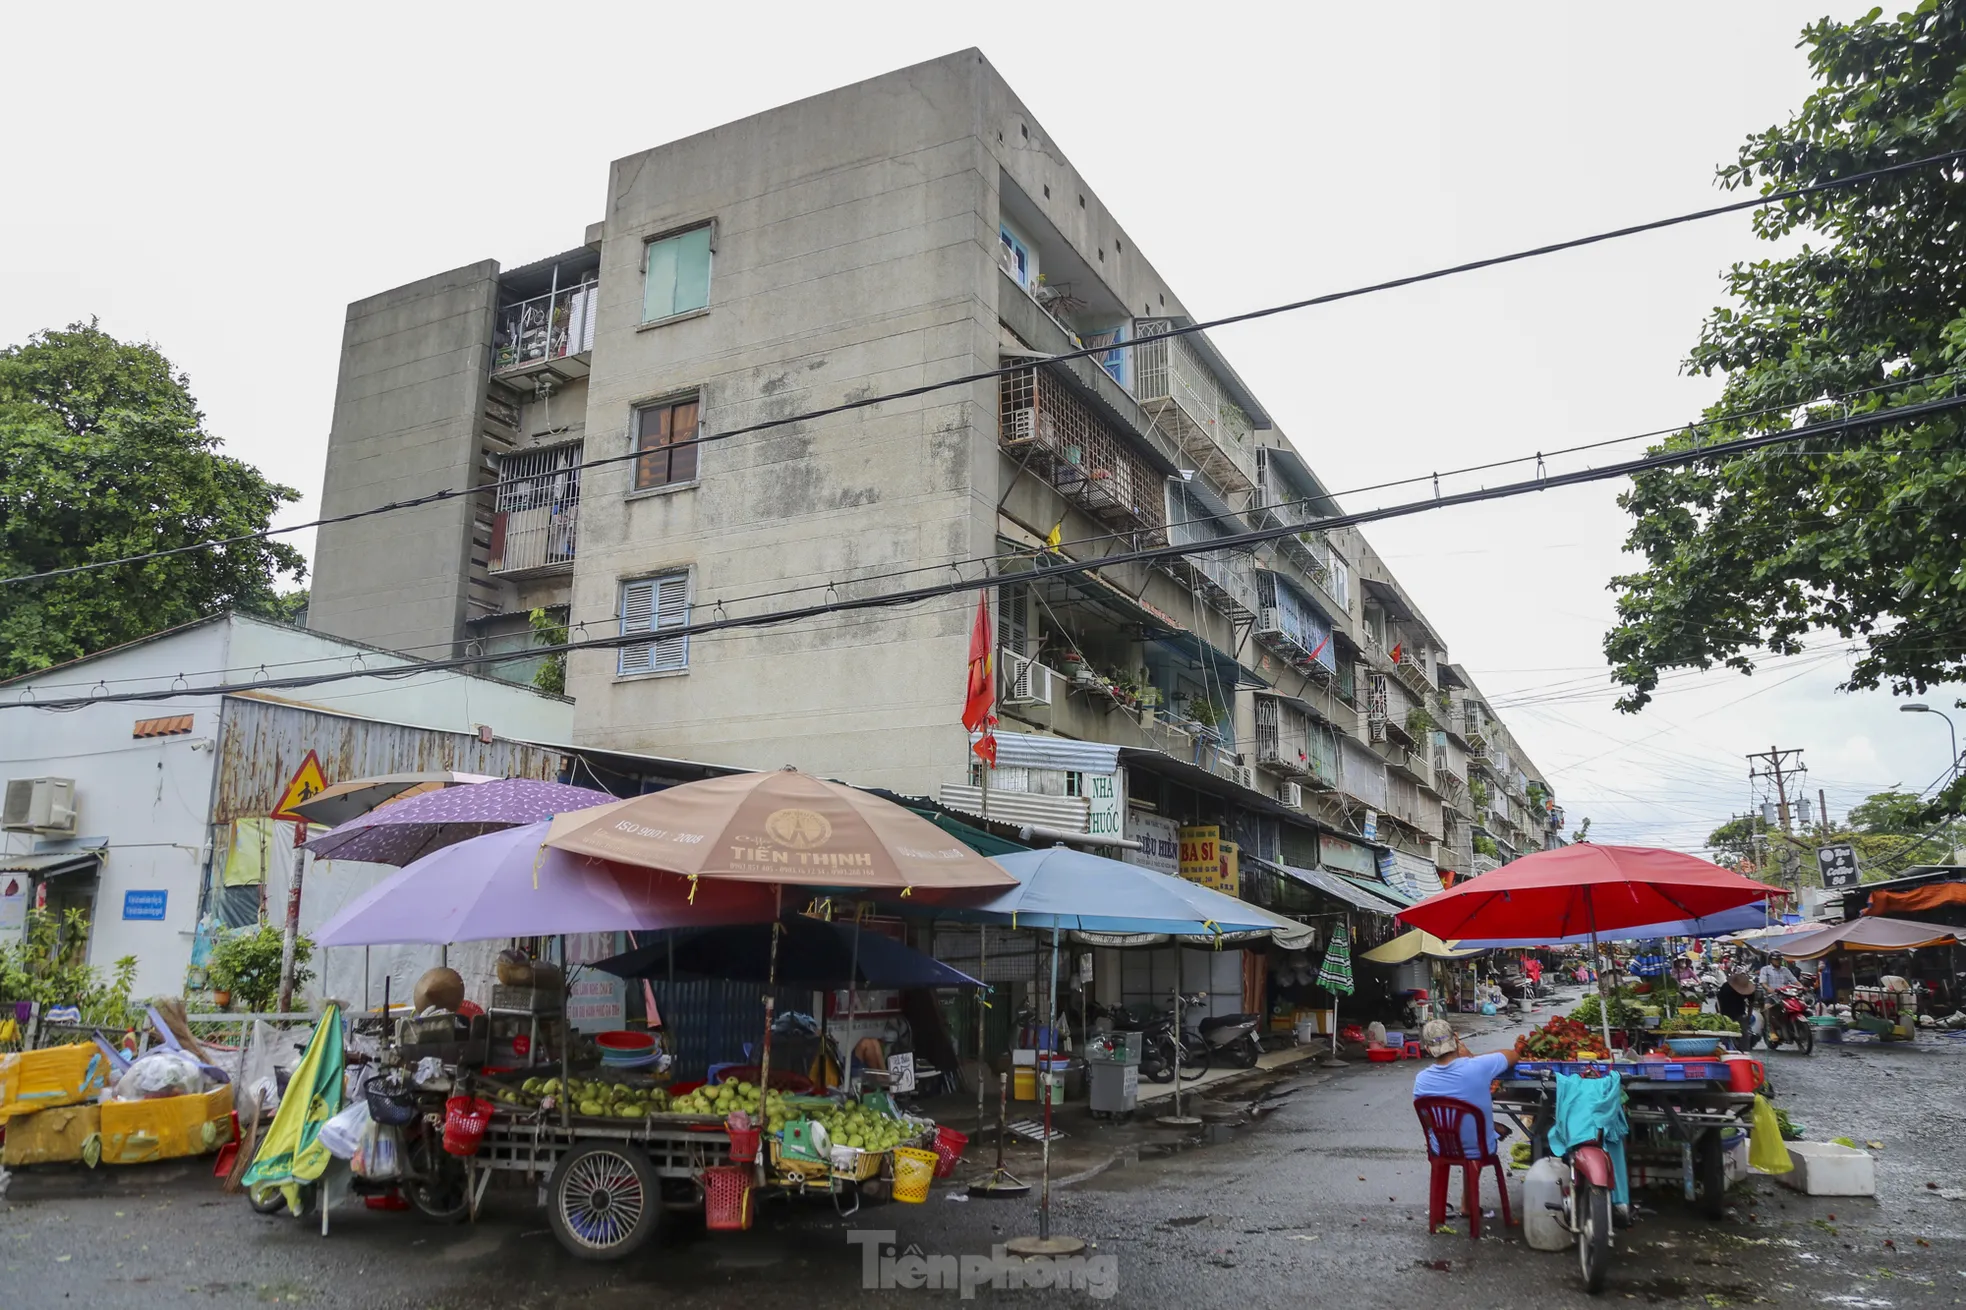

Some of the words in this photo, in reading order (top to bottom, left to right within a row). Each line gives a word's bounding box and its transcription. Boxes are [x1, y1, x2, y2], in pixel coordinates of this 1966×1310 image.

[615, 819, 640, 833] ISO
[637, 826, 668, 840] 9001
[673, 832, 705, 844] 2008
[730, 844, 788, 864] TIẾN
[796, 852, 872, 869] THỊNH
[1159, 832, 1178, 861] HIỀN
[1181, 842, 1198, 862] BA
[1826, 866, 1854, 876] Coffee
